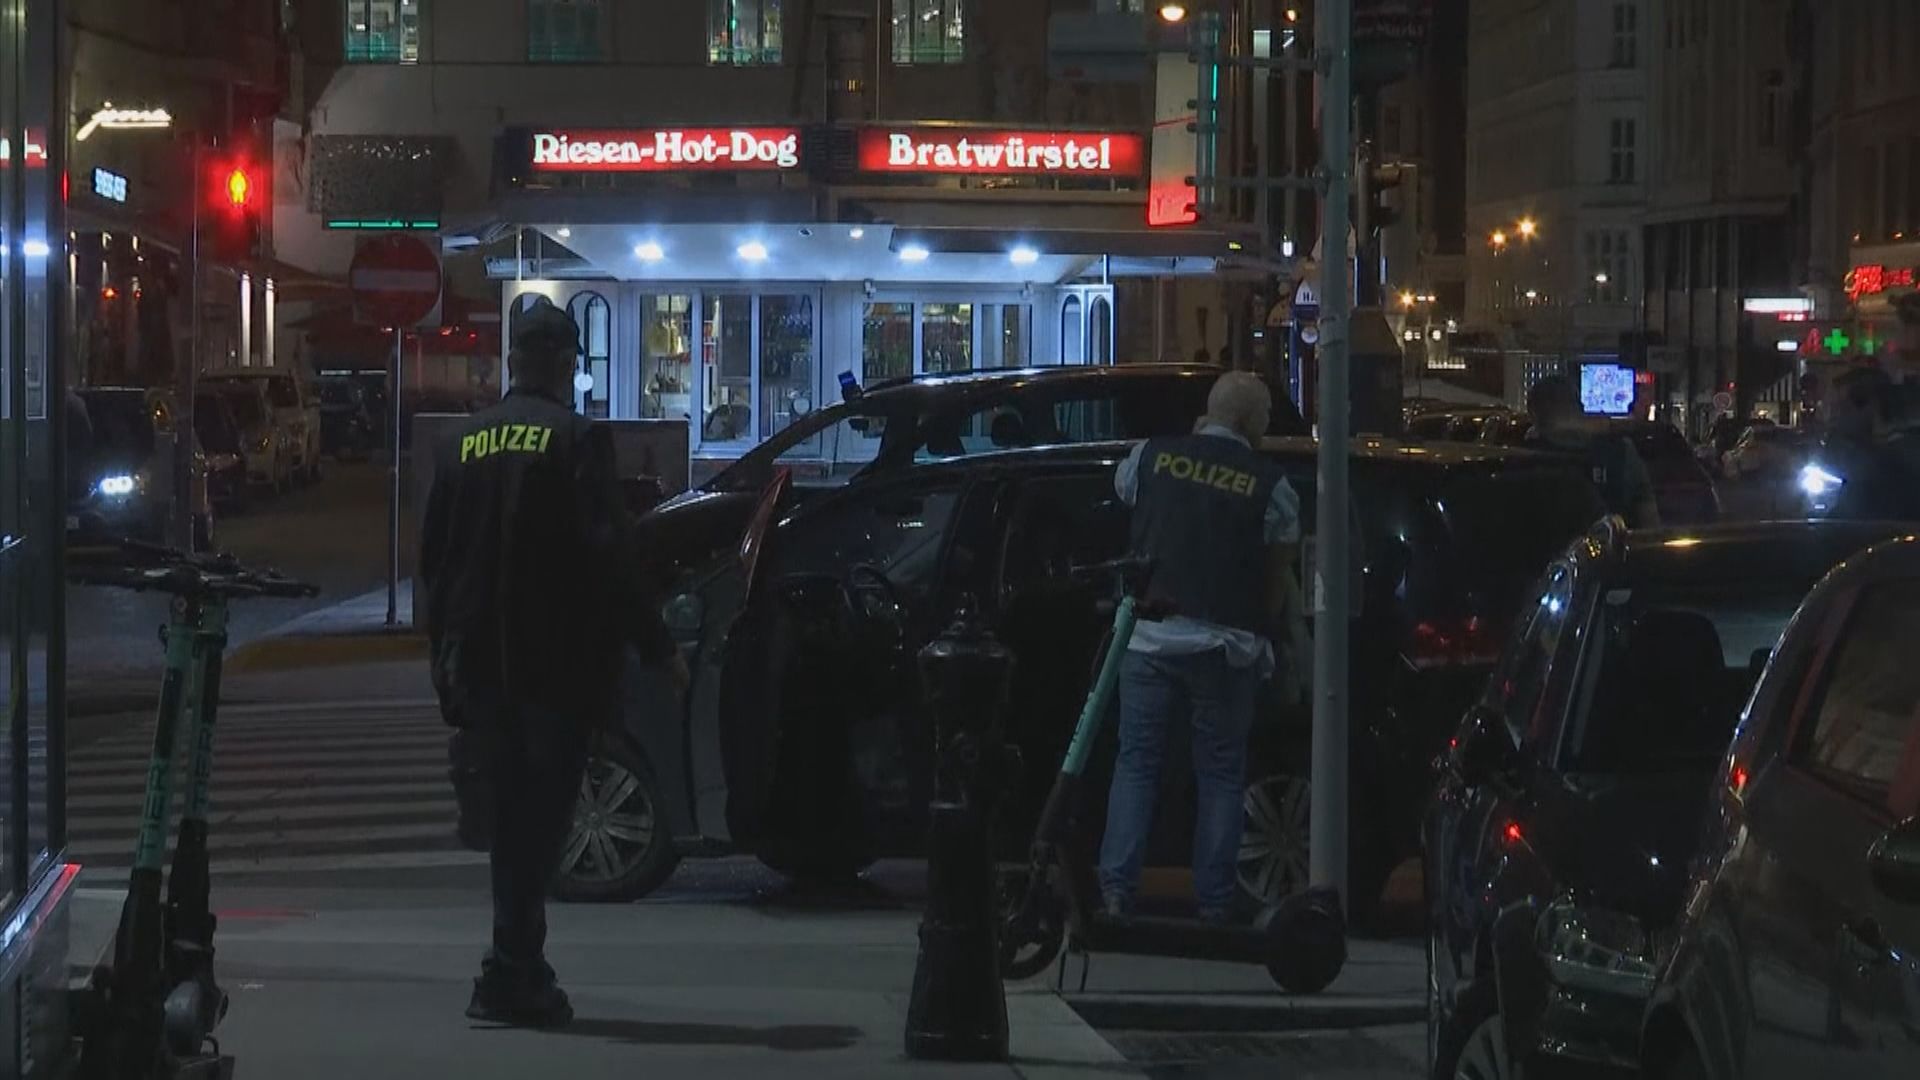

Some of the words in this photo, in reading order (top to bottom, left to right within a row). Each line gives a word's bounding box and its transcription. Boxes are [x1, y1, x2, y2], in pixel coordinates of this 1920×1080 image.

[533, 131, 798, 166] Riesen-Hot-Dog
[889, 133, 1111, 169] Bratwürstel
[460, 424, 552, 463] POLIZEI
[1153, 452, 1256, 496] POLIZEI
